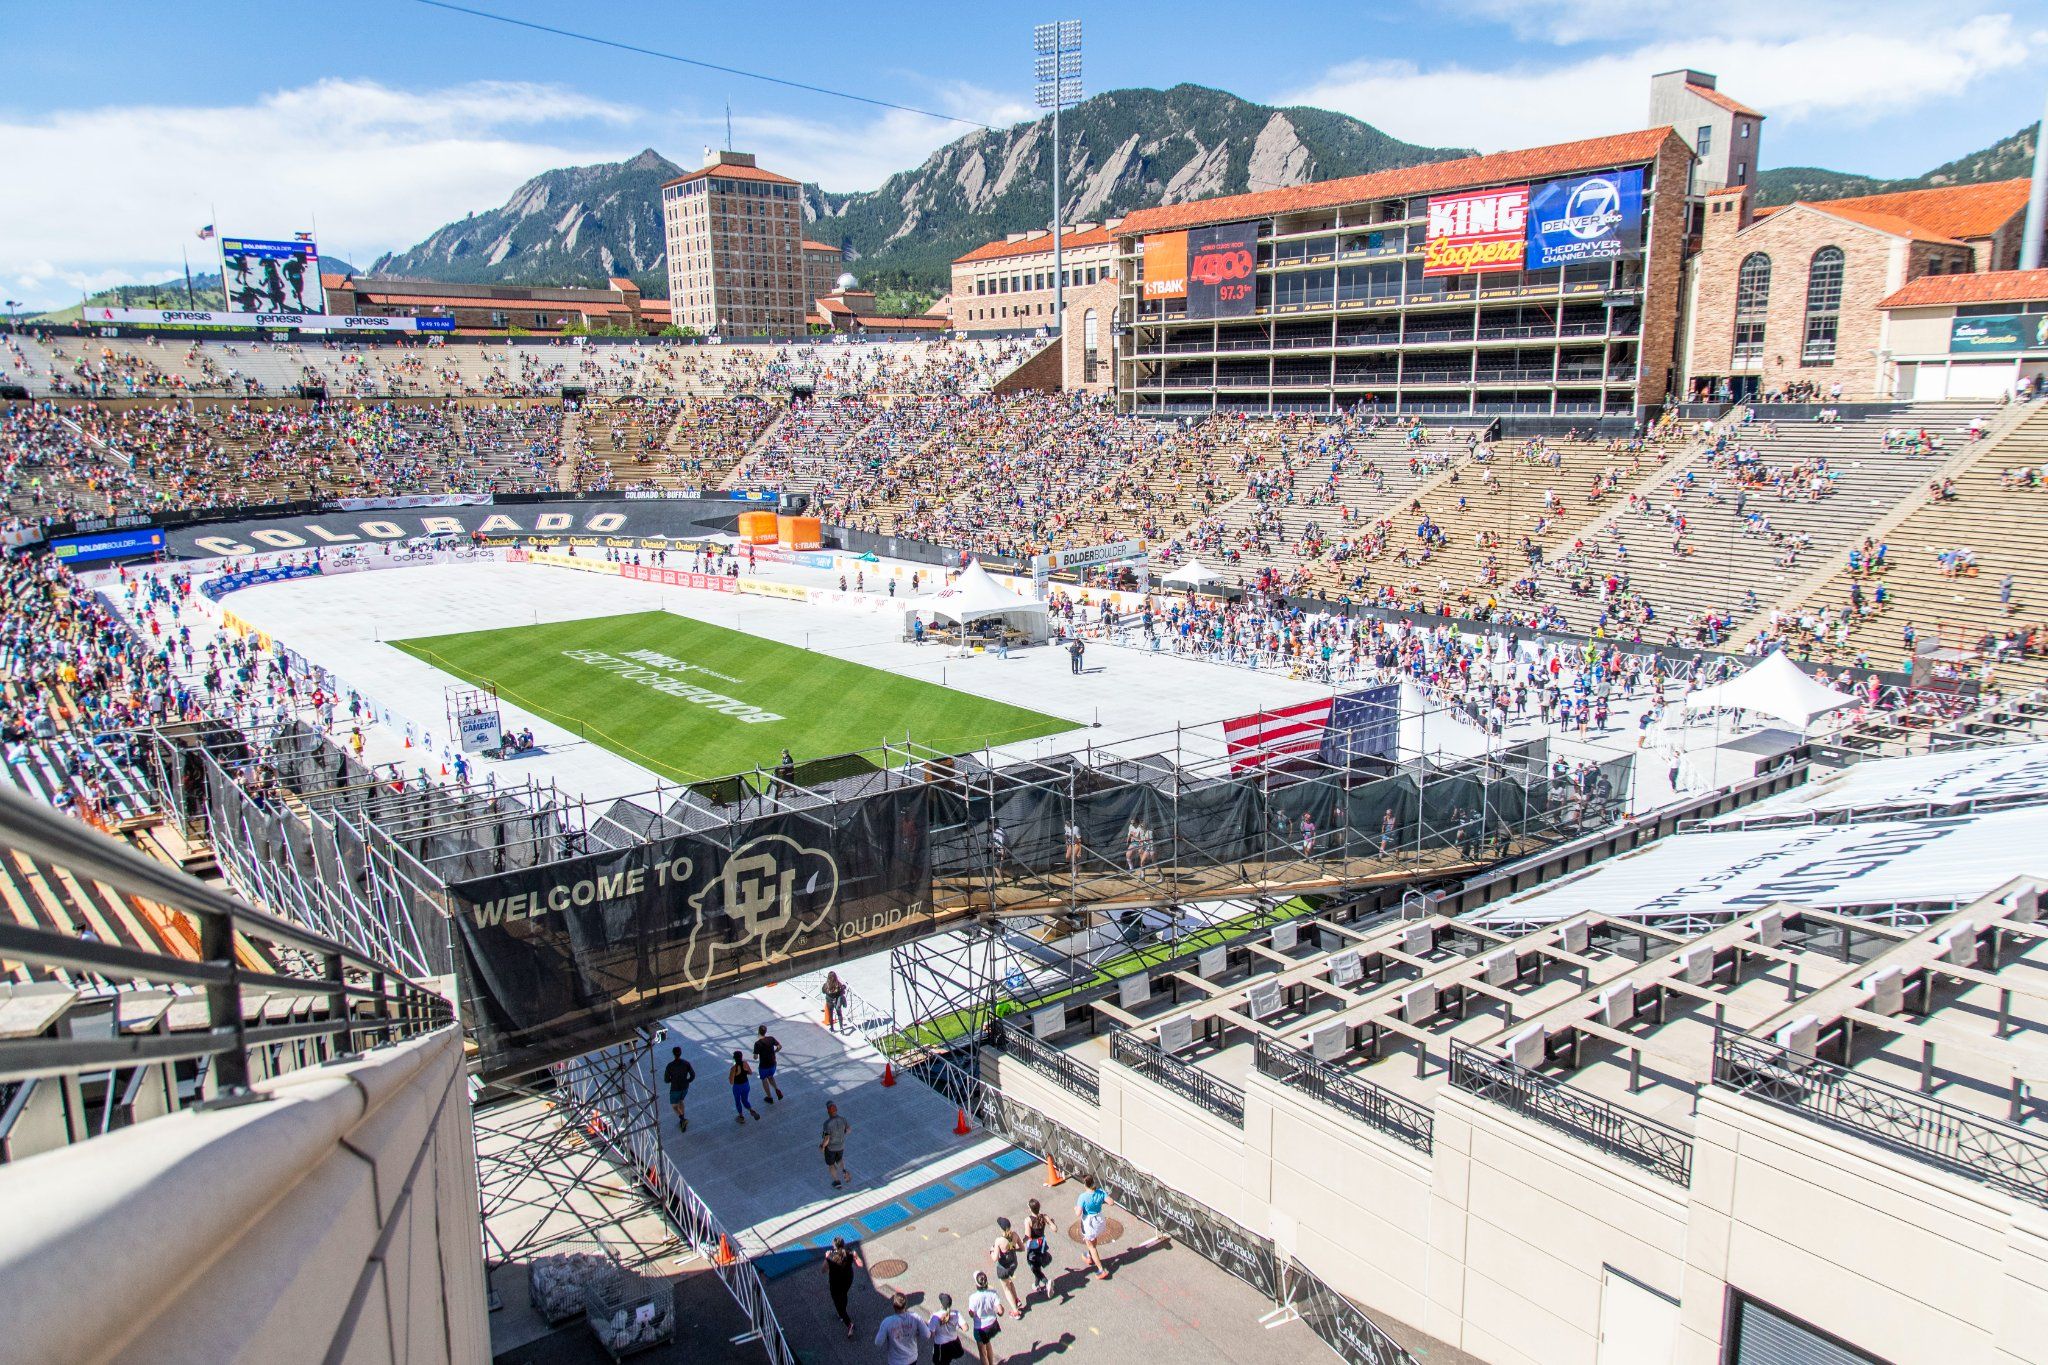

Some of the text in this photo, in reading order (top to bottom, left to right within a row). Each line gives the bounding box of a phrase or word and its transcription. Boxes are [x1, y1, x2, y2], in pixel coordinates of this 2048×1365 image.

[1428, 194, 1523, 239] KING
[1543, 187, 1616, 238] DENVER 7
[1424, 236, 1530, 273] Soopers
[1541, 248, 1621, 264] CHANNEL.COM
[1220, 286, 1244, 300] 97.3
[162, 311, 212, 322] genesis
[256, 315, 303, 325] genesis
[345, 316, 389, 326] genesis
[101, 328, 118, 337] 210
[272, 332, 288, 342] 209
[625, 491, 701, 500] COLORADO BUFFALOES
[194, 512, 628, 557] COLORADO
[78, 539, 136, 553] BOLDERBOULDER
[456, 550, 494, 559] OOFOS
[1063, 544, 1127, 566] BOLDERBOULDER
[332, 557, 370, 568] OOFOS
[393, 552, 434, 562] OOFOS
[462, 720, 496, 732] CAMERA!
[472, 856, 694, 930] WELCOME TO
[724, 852, 796, 936] CU
[832, 916, 866, 942] YOU
[872, 908, 902, 930] DID
[1011, 1114, 1042, 1139] Colorado
[1106, 1166, 1140, 1196] Colorado
[1158, 1196, 1194, 1228] Colorado
[1216, 1230, 1256, 1264] Colorado
[1336, 1316, 1378, 1364] Colorado
